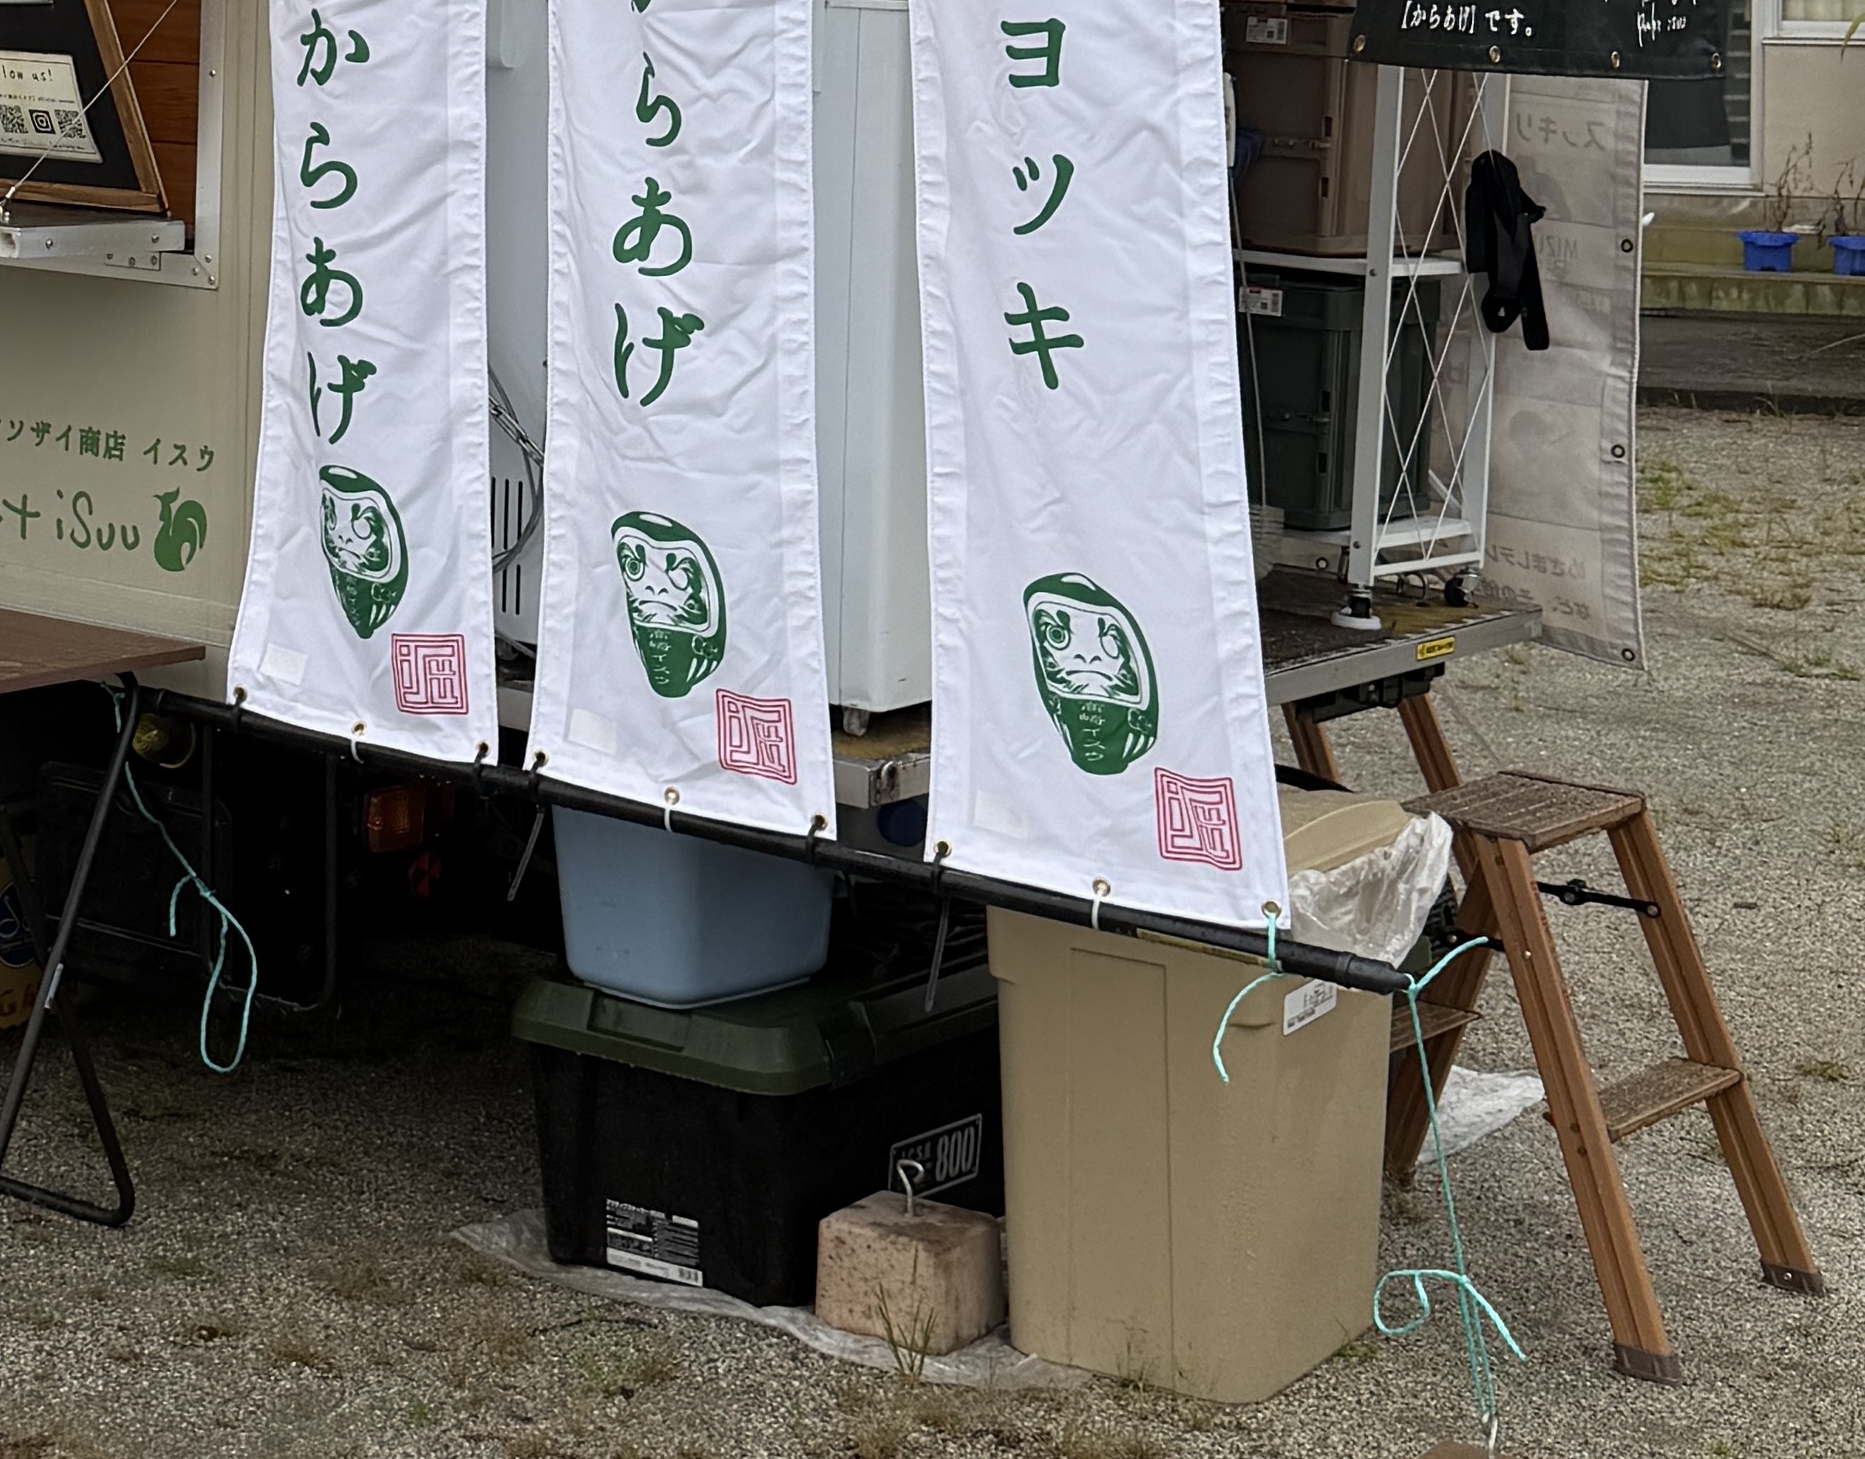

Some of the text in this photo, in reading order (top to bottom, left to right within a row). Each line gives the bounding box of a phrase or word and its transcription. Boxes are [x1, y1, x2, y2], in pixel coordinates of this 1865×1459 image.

[31, 68, 53, 82] us!
[143, 438, 214, 471] イスウ
[935, 1126, 975, 1182] 800
